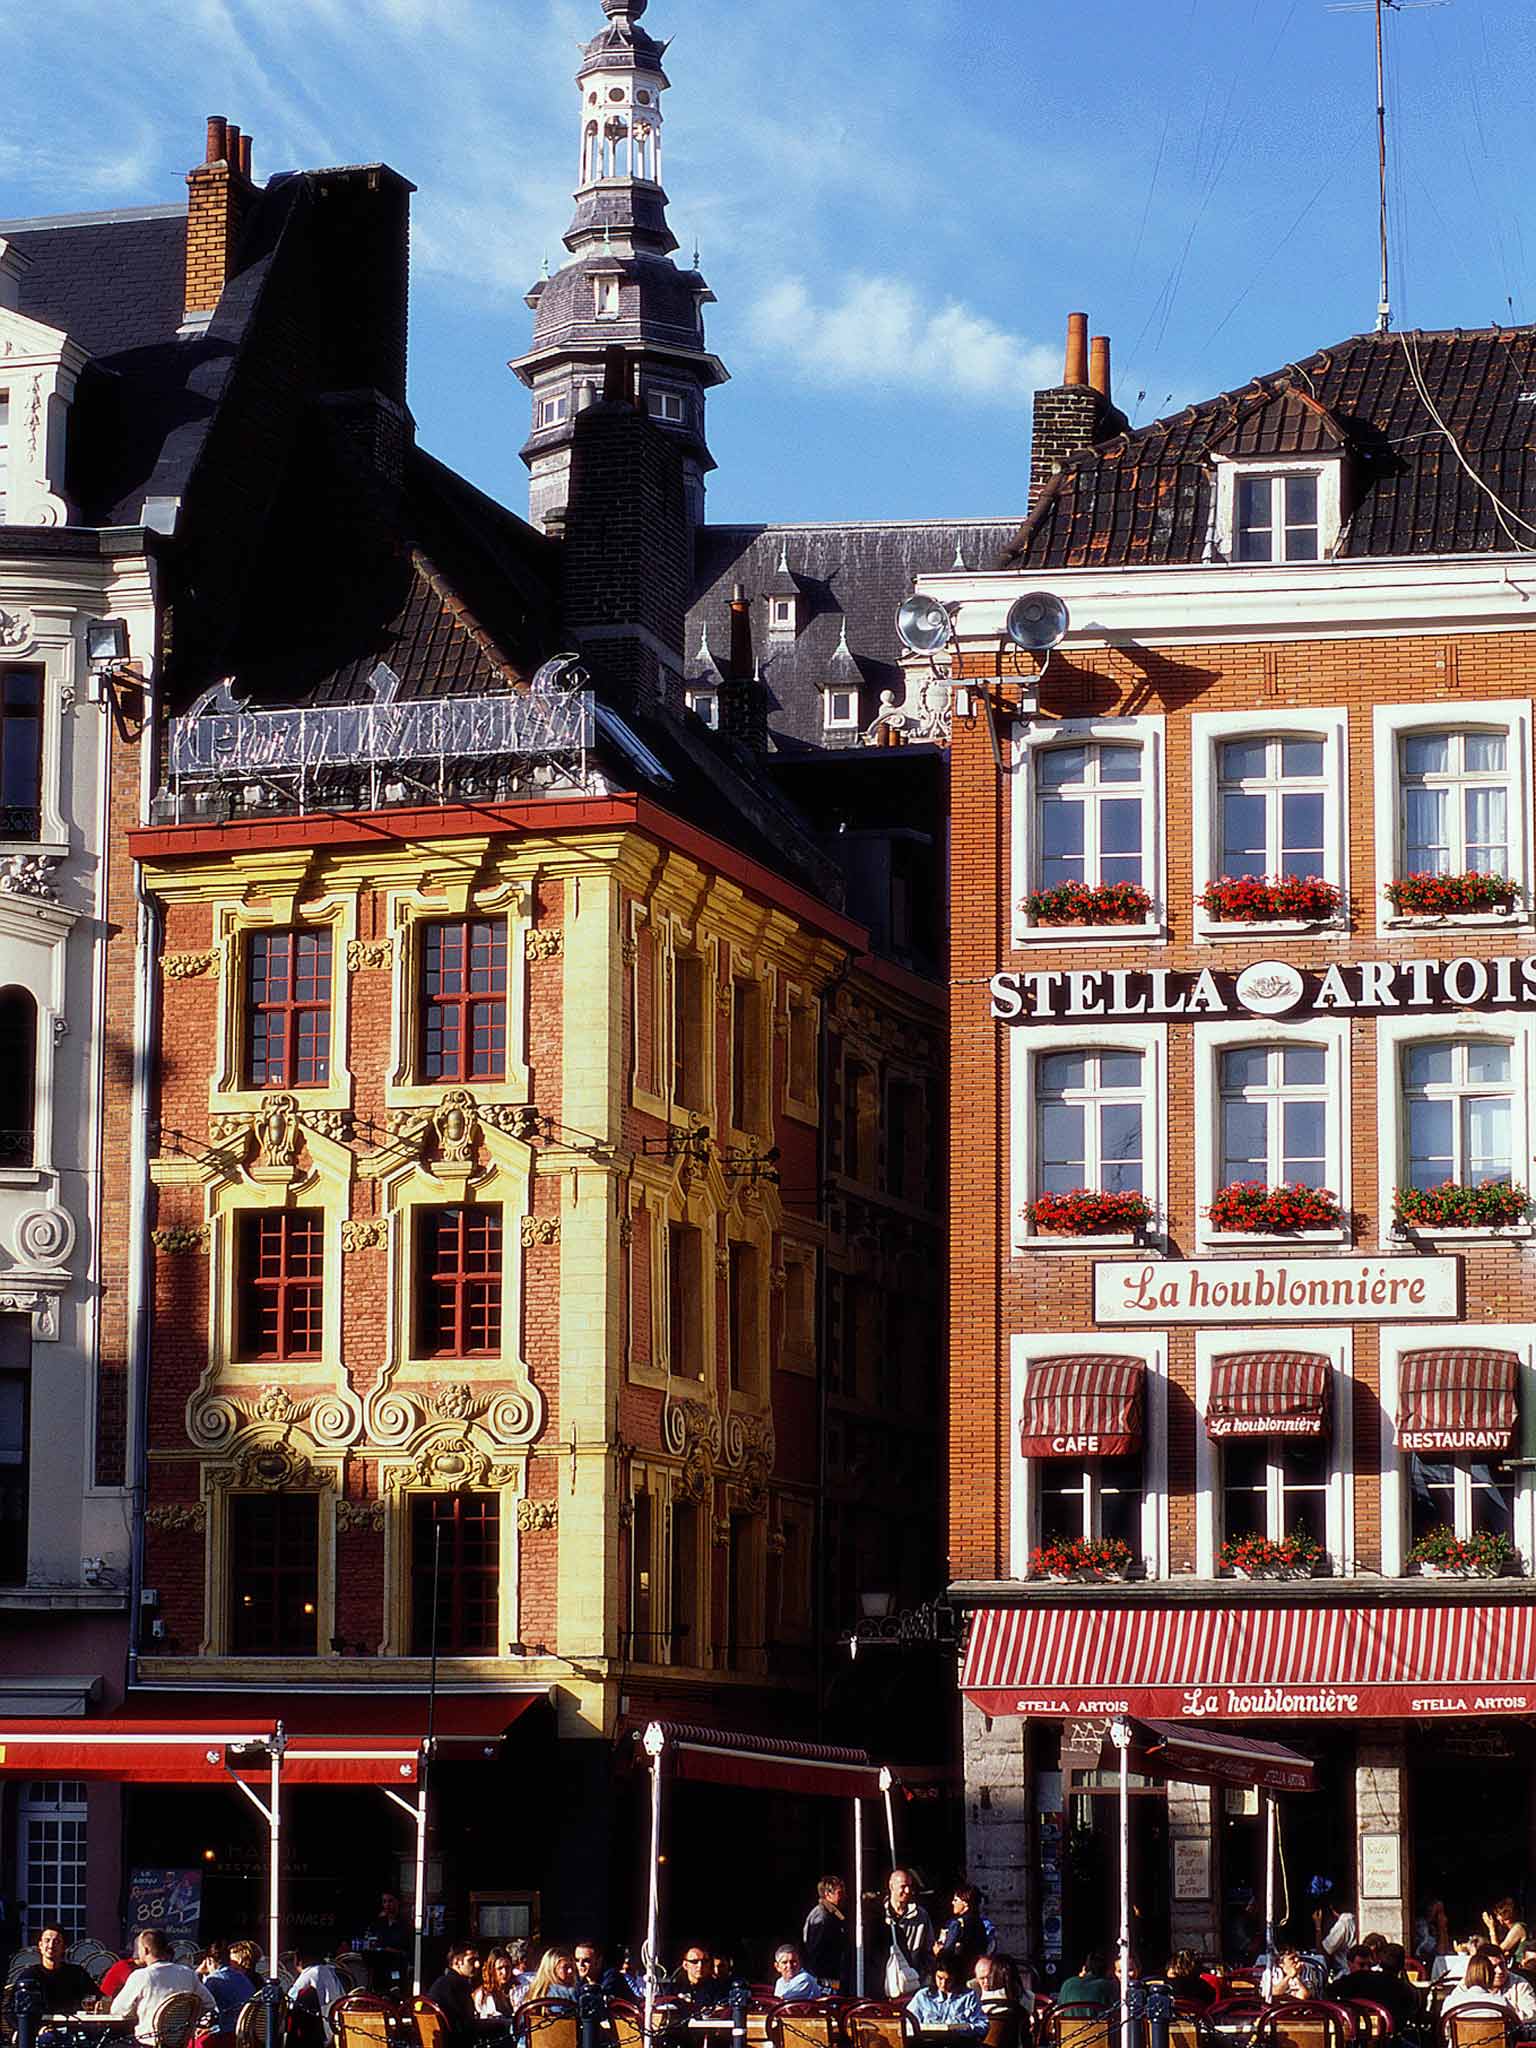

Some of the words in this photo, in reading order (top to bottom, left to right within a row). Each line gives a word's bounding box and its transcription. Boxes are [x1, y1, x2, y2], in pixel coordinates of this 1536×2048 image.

[990, 968, 1227, 1018] STELLA
[1123, 1266, 1180, 1311] La
[1210, 1418, 1232, 1435] La
[1235, 1417, 1321, 1433] houblonnière
[1052, 1436, 1099, 1453] CAFE
[1402, 1431, 1511, 1448] RESTAURANT
[1016, 1701, 1070, 1712] STELLA
[1077, 1700, 1129, 1713] ARTOIS
[1182, 1688, 1219, 1716] La
[1227, 1688, 1358, 1713] houblonnière
[1411, 1698, 1468, 1711] STELLA
[1474, 1697, 1527, 1709] ARTOIS
